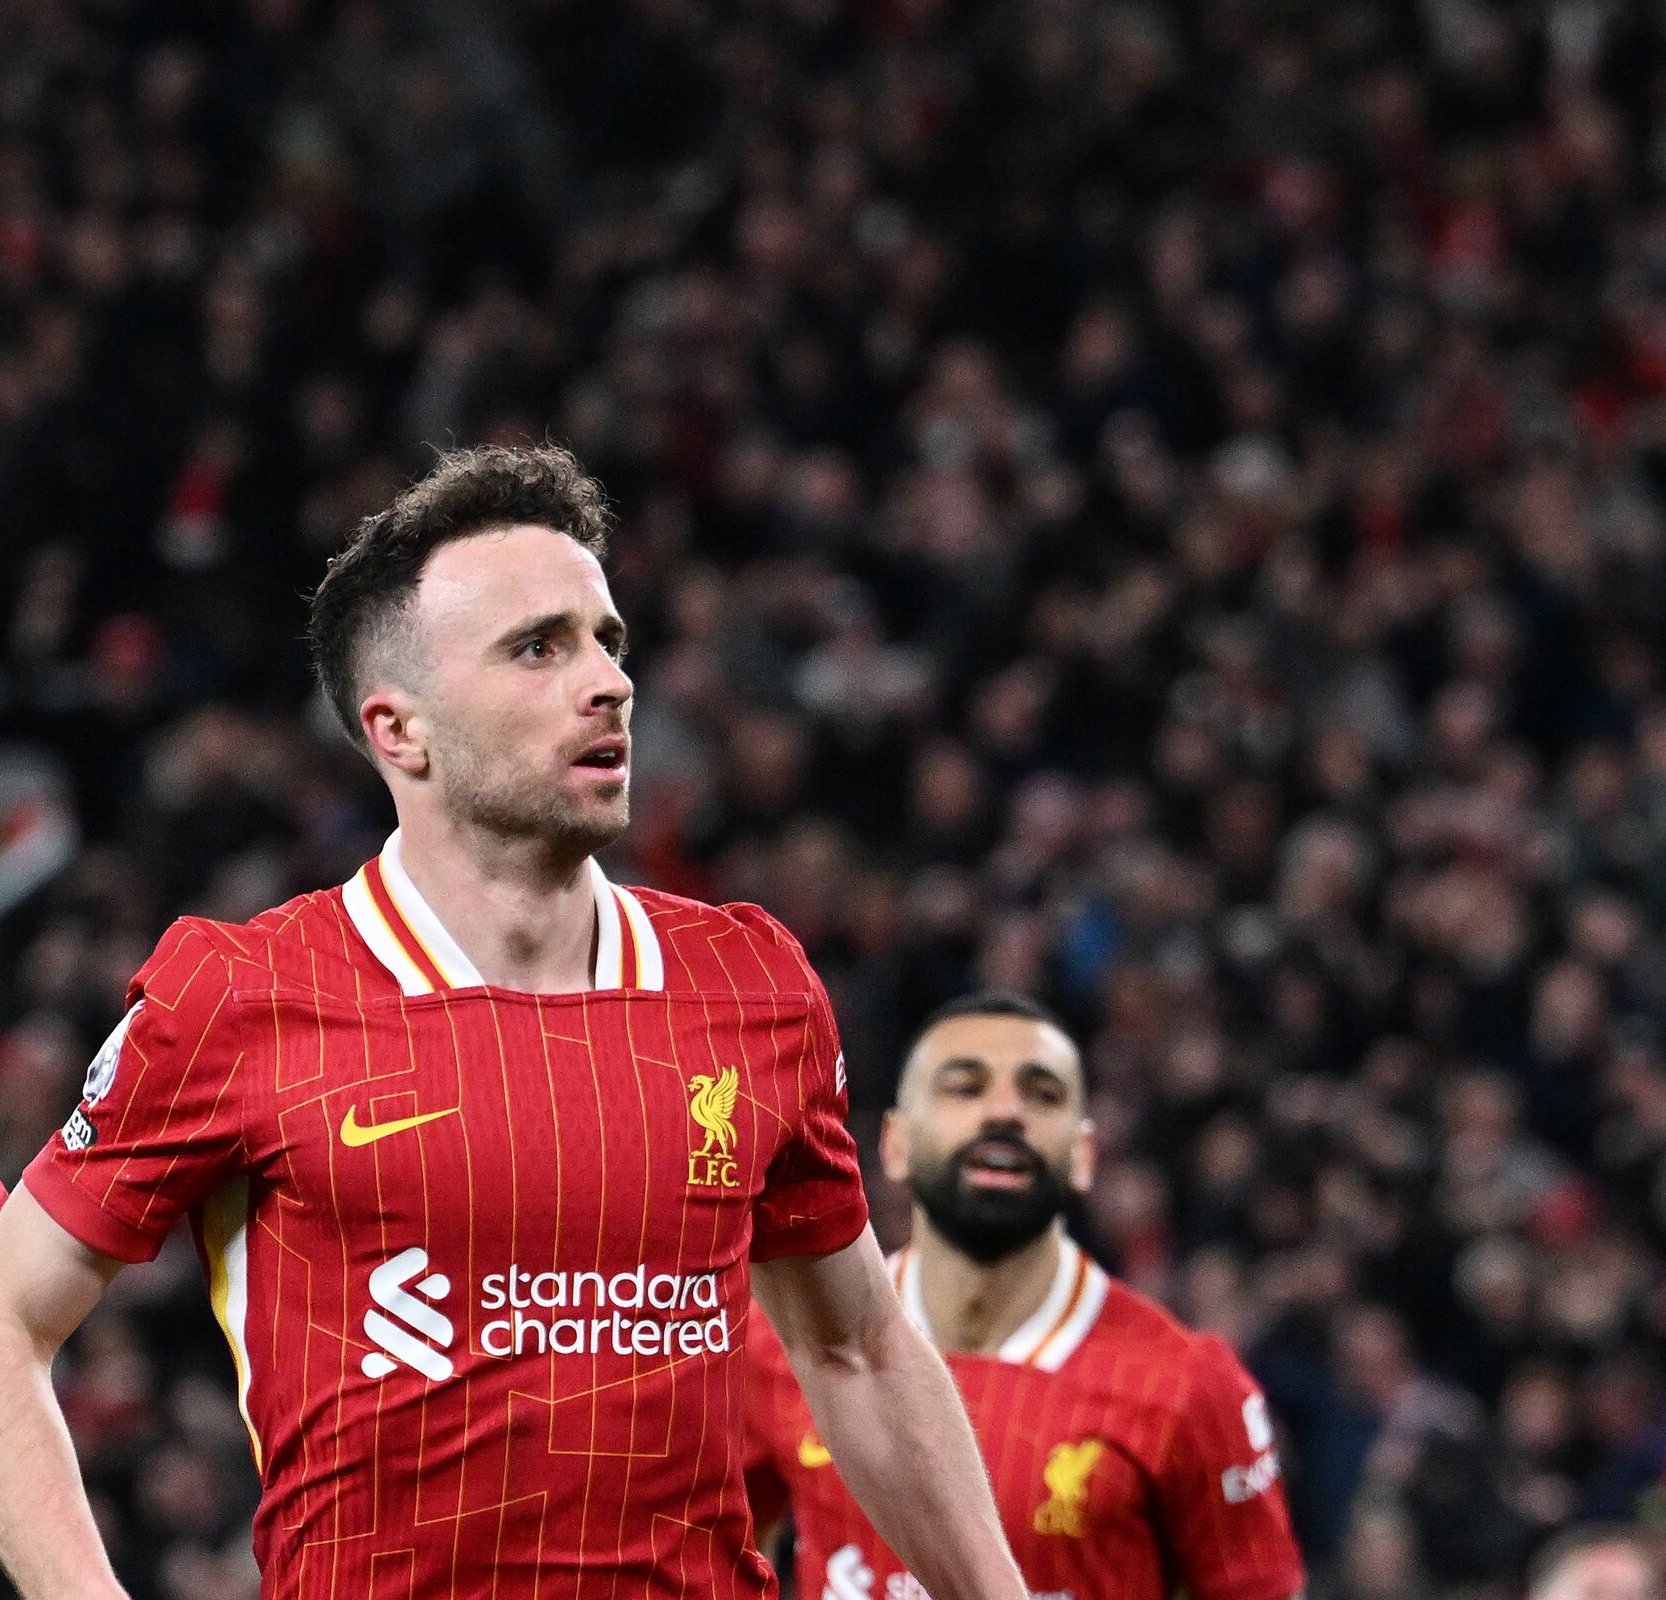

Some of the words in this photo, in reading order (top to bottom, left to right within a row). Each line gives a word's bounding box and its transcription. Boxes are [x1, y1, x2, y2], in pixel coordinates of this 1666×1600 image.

[687, 1158, 741, 1188] L.F.C.
[480, 1263, 719, 1311] standard
[480, 1308, 730, 1356] chartered
